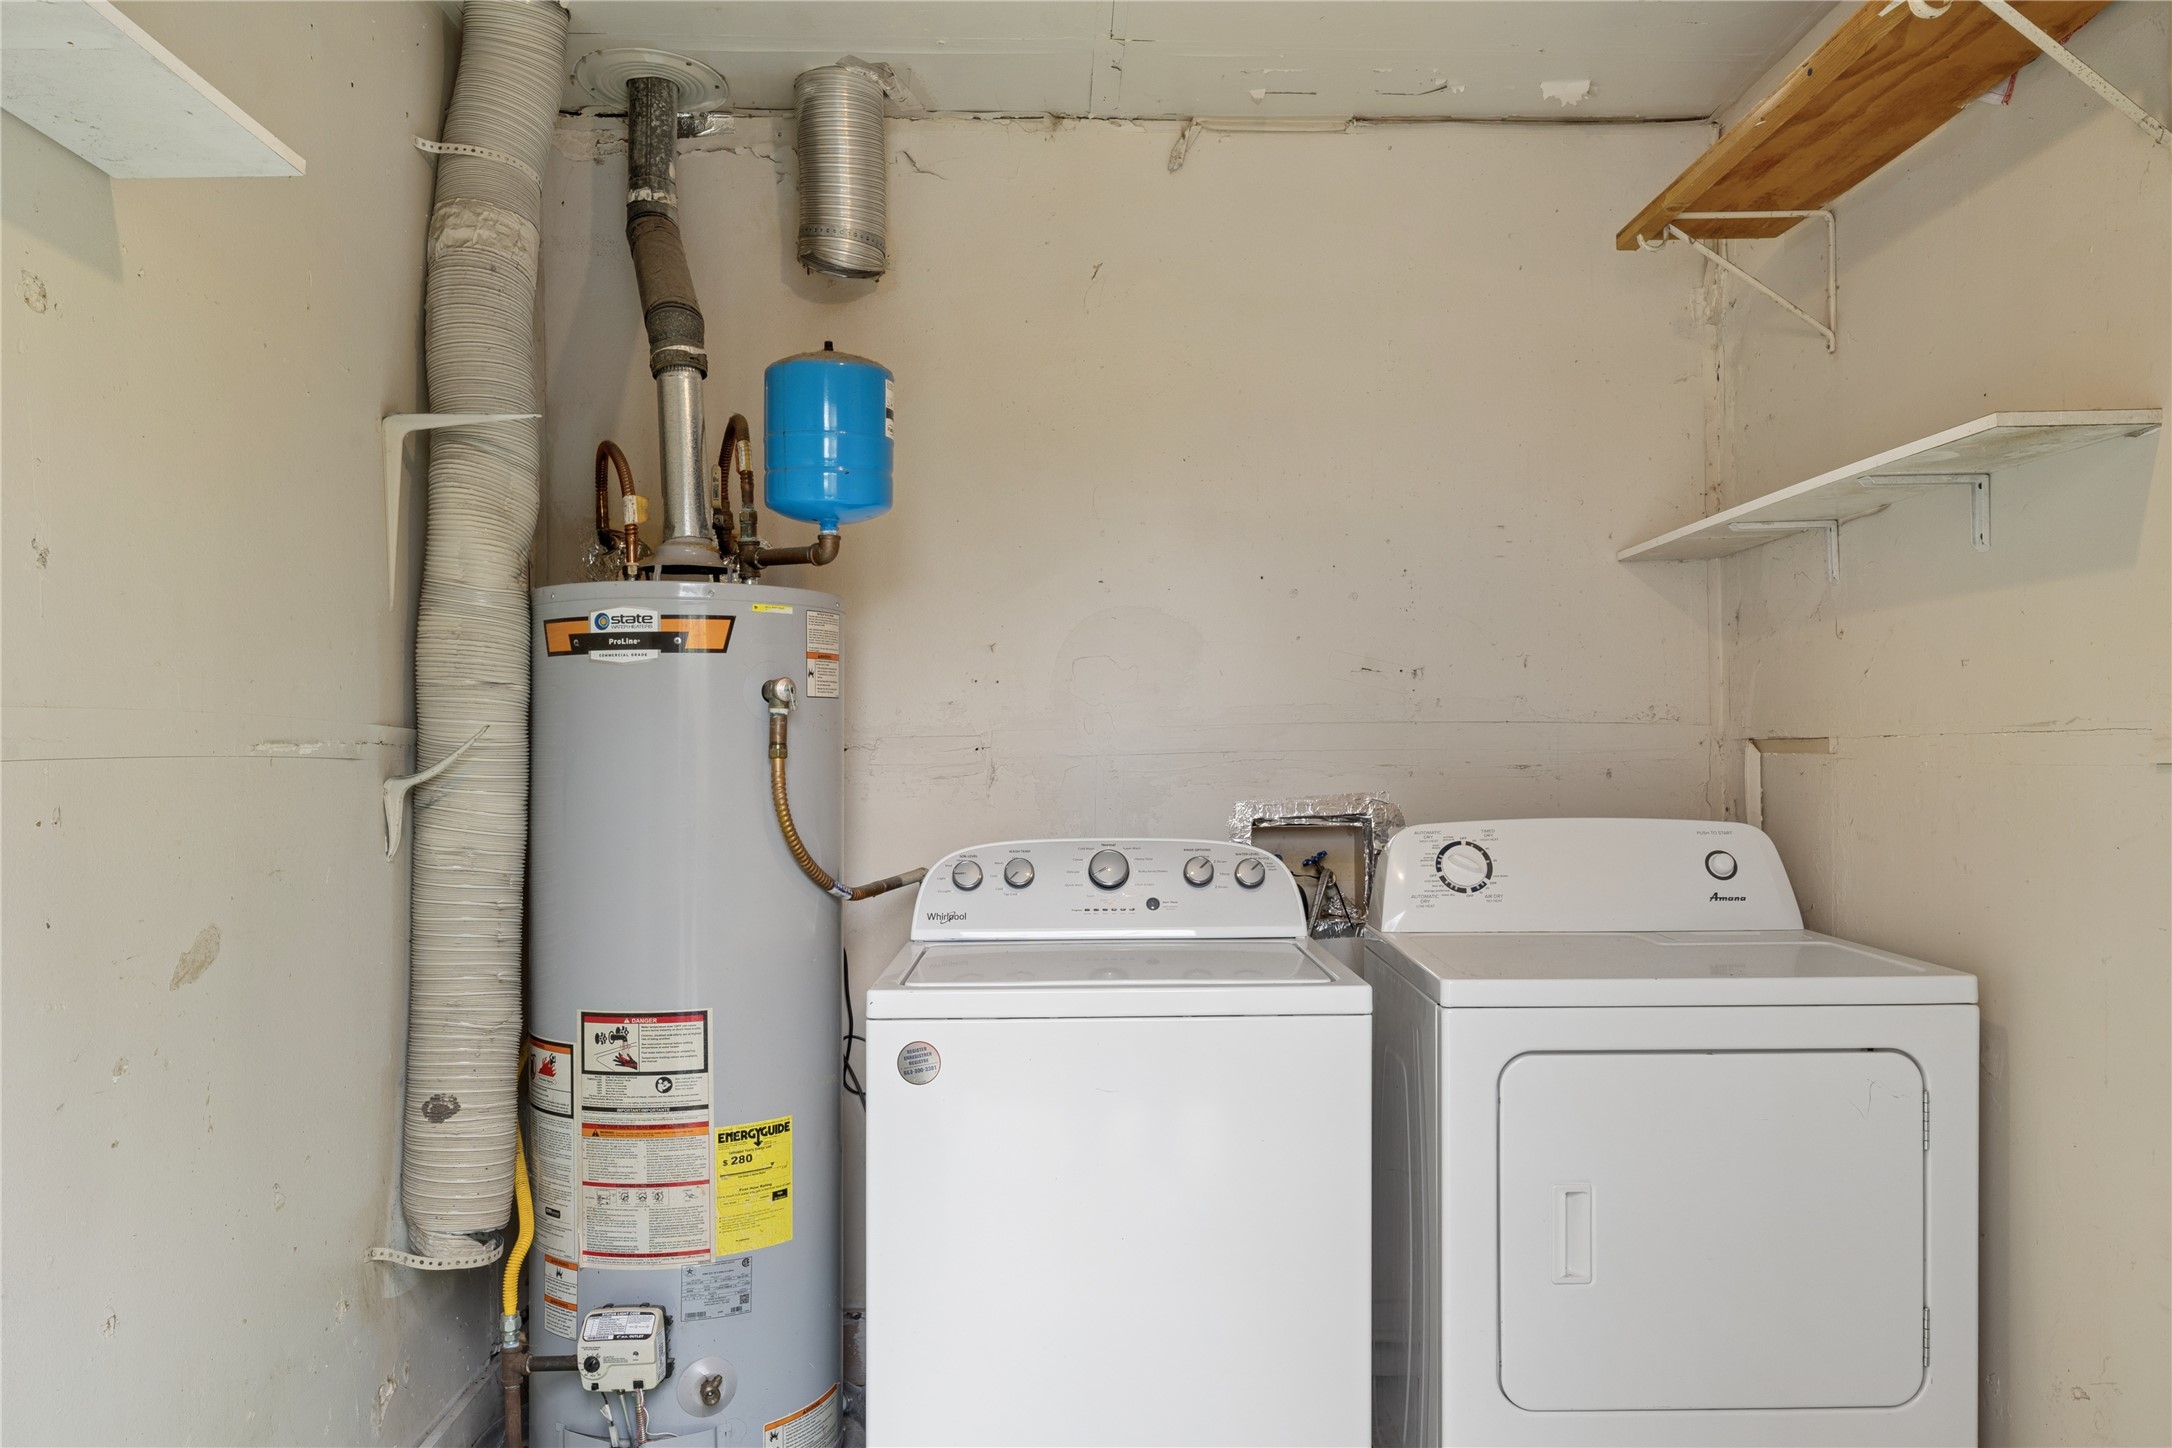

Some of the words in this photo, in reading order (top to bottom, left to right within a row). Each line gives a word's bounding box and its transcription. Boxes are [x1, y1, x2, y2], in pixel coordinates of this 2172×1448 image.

[611, 614, 653, 625] state
[1709, 892, 1747, 902] Amana
[926, 911, 967, 924] Whirlpool
[718, 1121, 791, 1146] ENERGYGUIDE
[731, 1154, 753, 1165] 280
